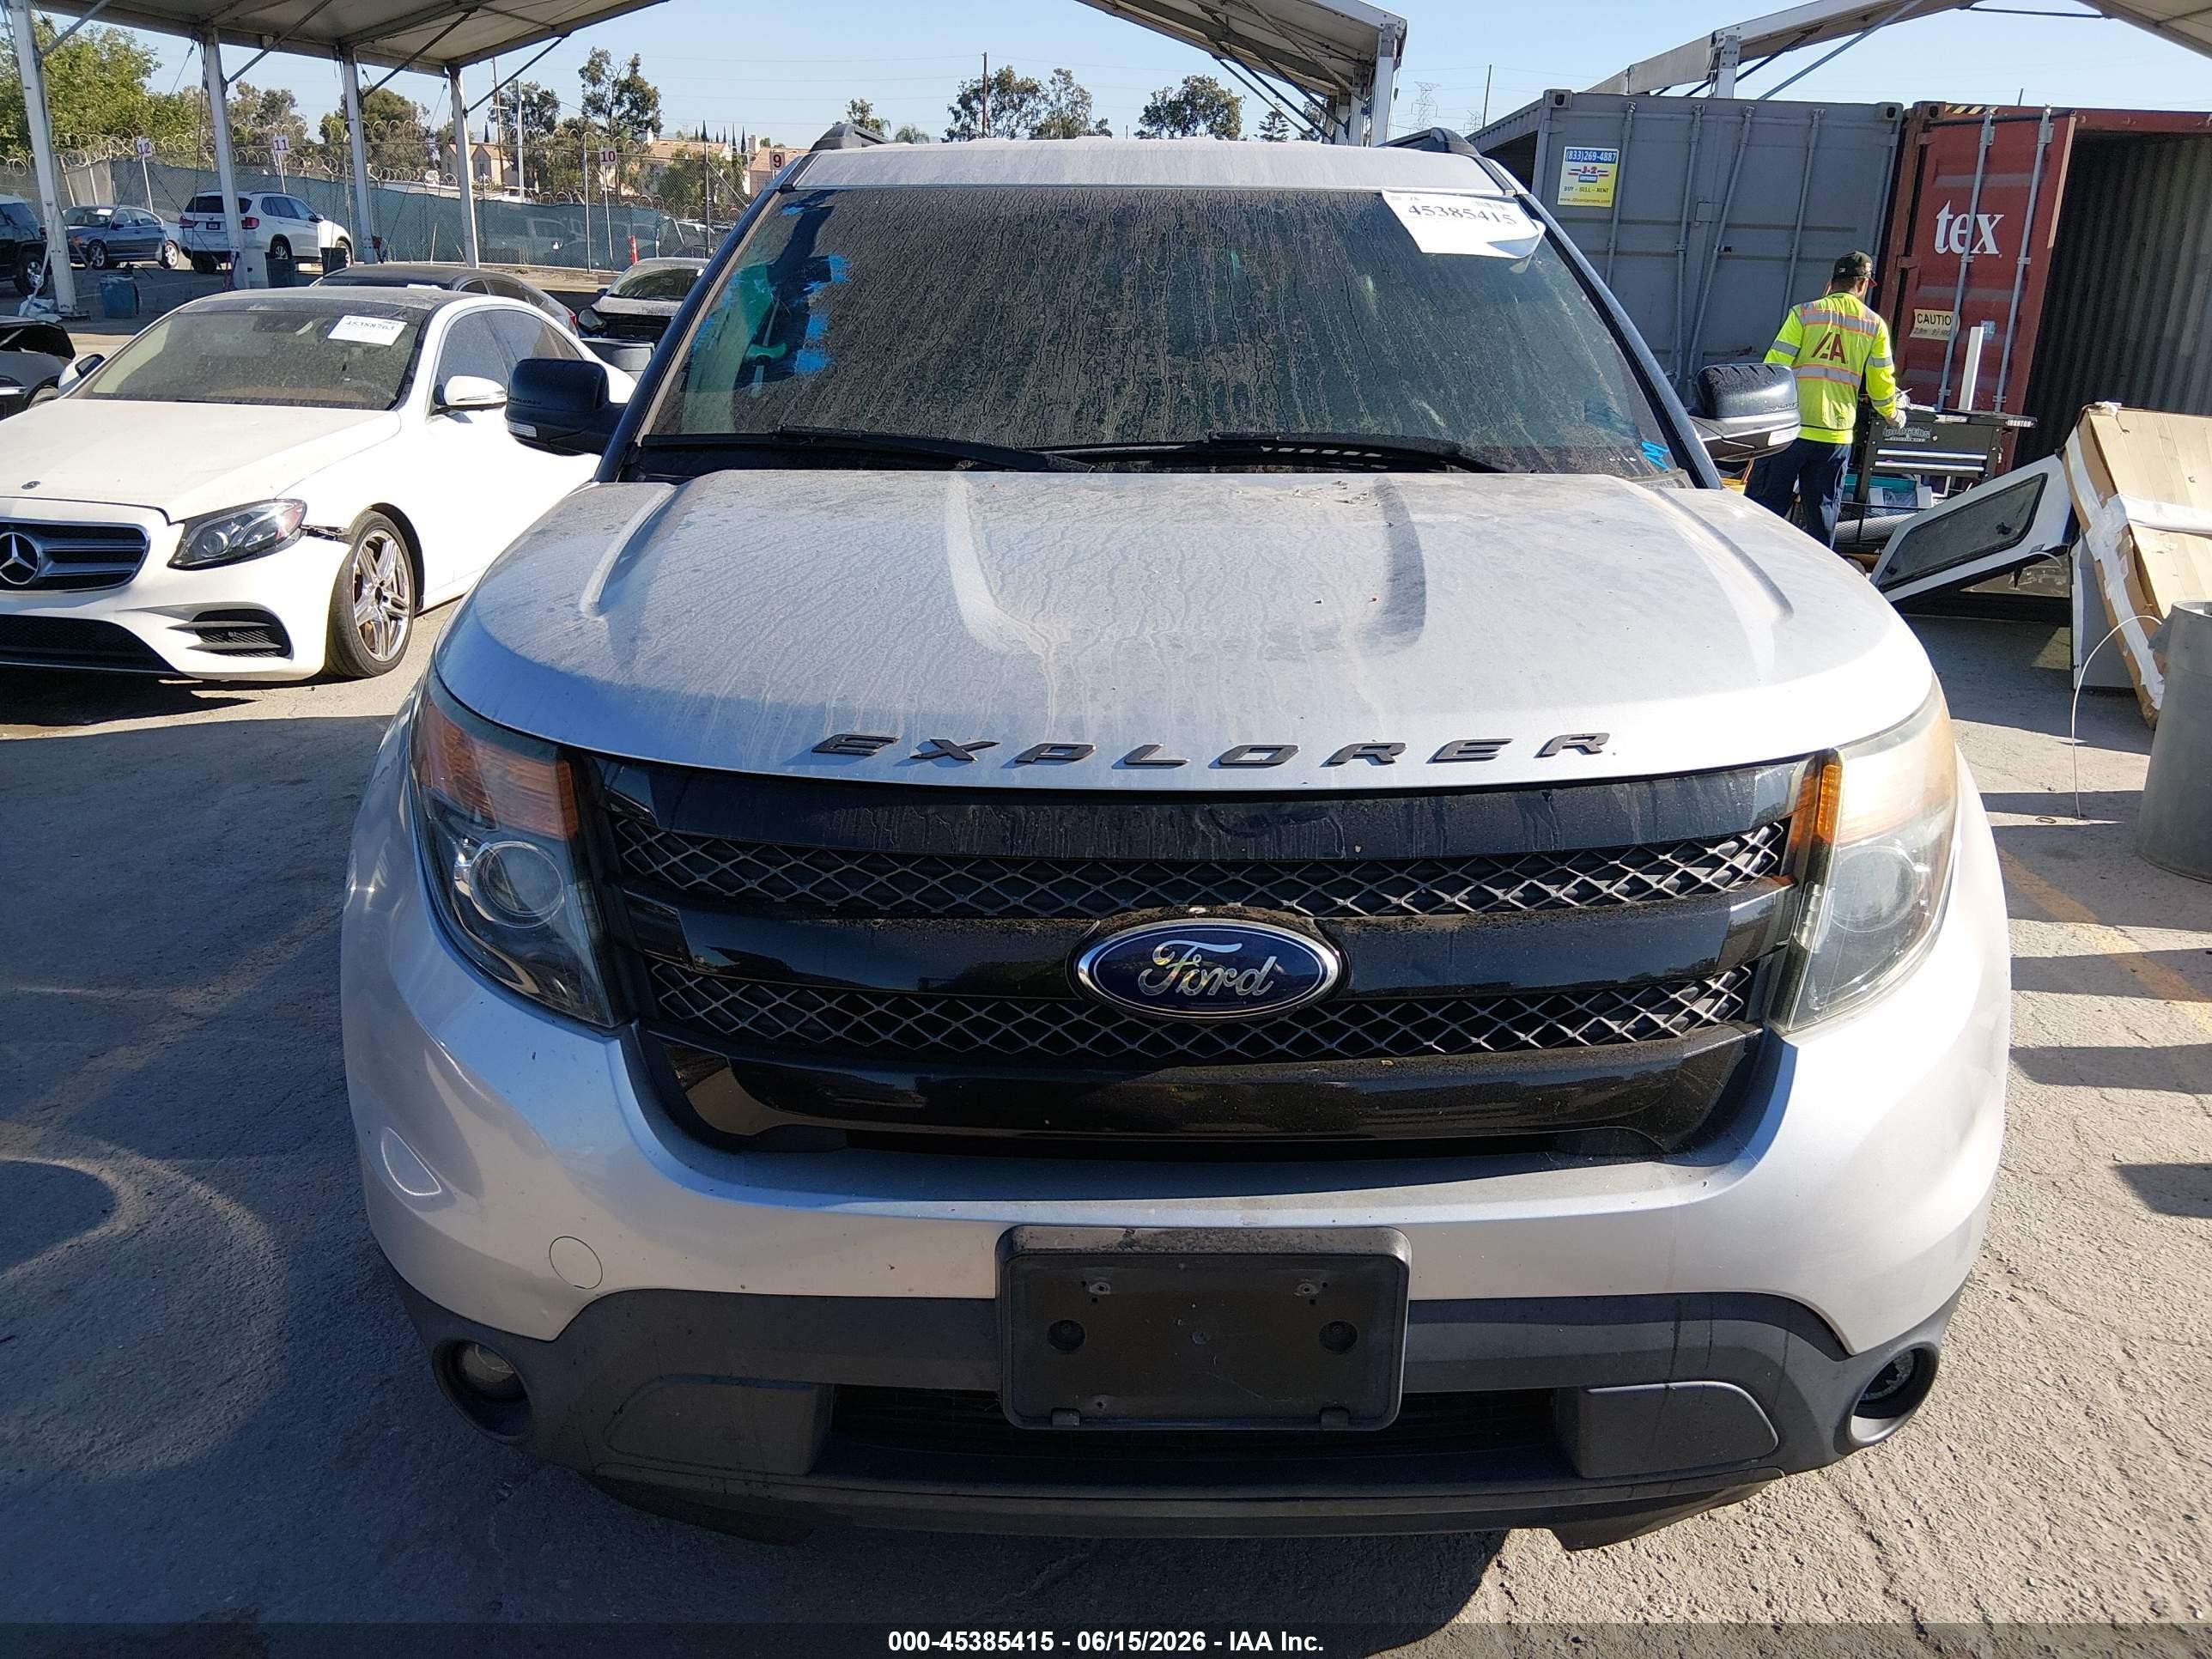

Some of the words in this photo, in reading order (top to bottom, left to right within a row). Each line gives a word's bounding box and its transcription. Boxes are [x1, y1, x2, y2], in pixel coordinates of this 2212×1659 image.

[138, 143, 151, 155] 12
[275, 140, 289, 151] 11
[601, 150, 616, 162] 10
[773, 154, 781, 167] 9
[1566, 150, 1616, 161] (833)269-4887
[1581, 166, 1597, 174] J-2
[1408, 204, 1516, 225] 45385415
[1934, 199, 2005, 255] tex
[1917, 313, 1952, 326] CAUTIO
[811, 732, 1610, 767] EXPLORER
[1138, 939, 1278, 996] Ford
